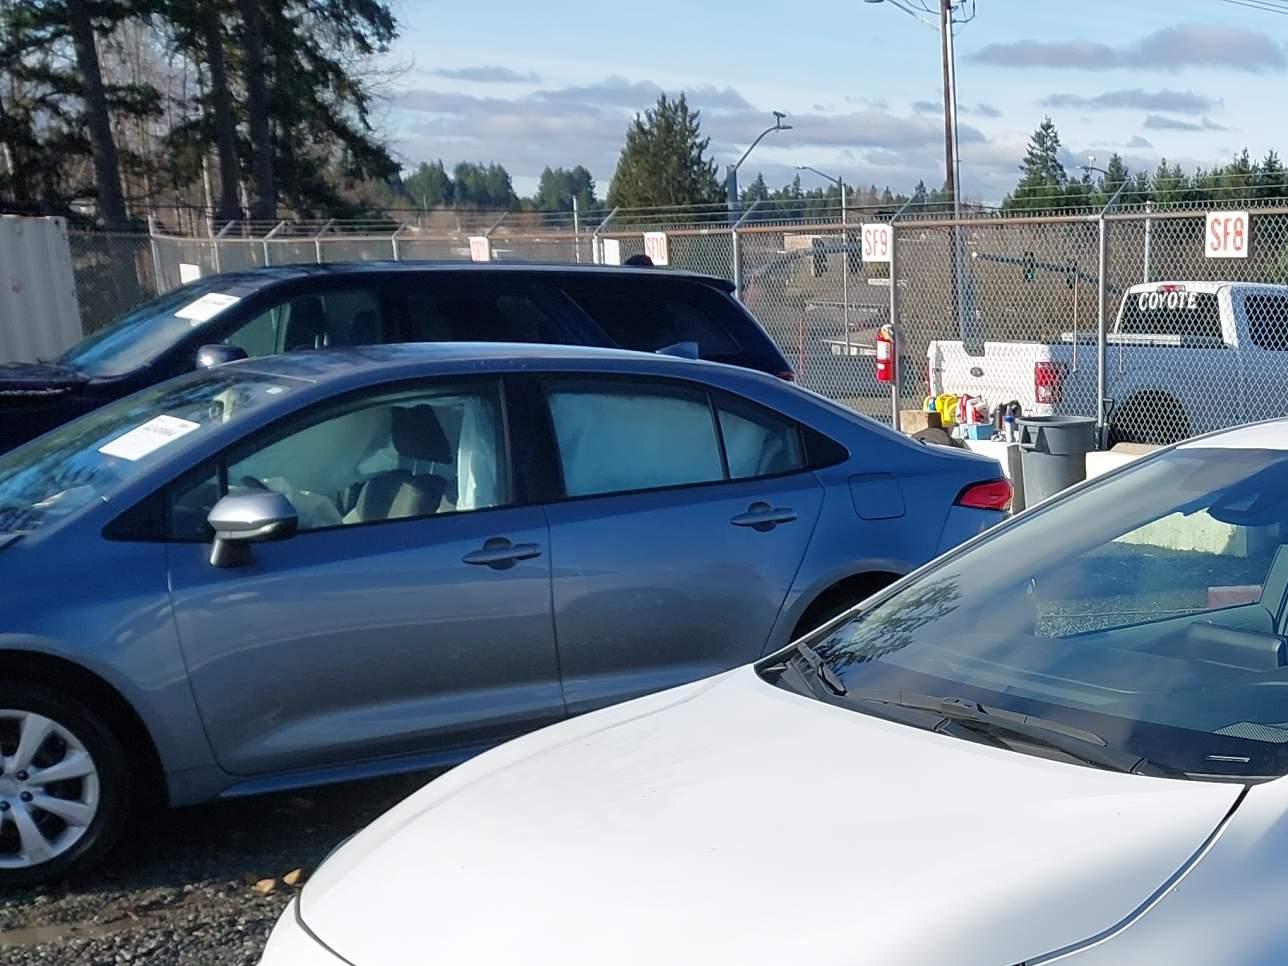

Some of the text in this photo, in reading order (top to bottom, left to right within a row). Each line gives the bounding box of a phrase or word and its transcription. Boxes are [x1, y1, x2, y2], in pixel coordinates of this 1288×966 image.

[865, 229, 887, 256] SF9
[1209, 216, 1244, 251] SF8
[1138, 291, 1198, 311] COYOTE
